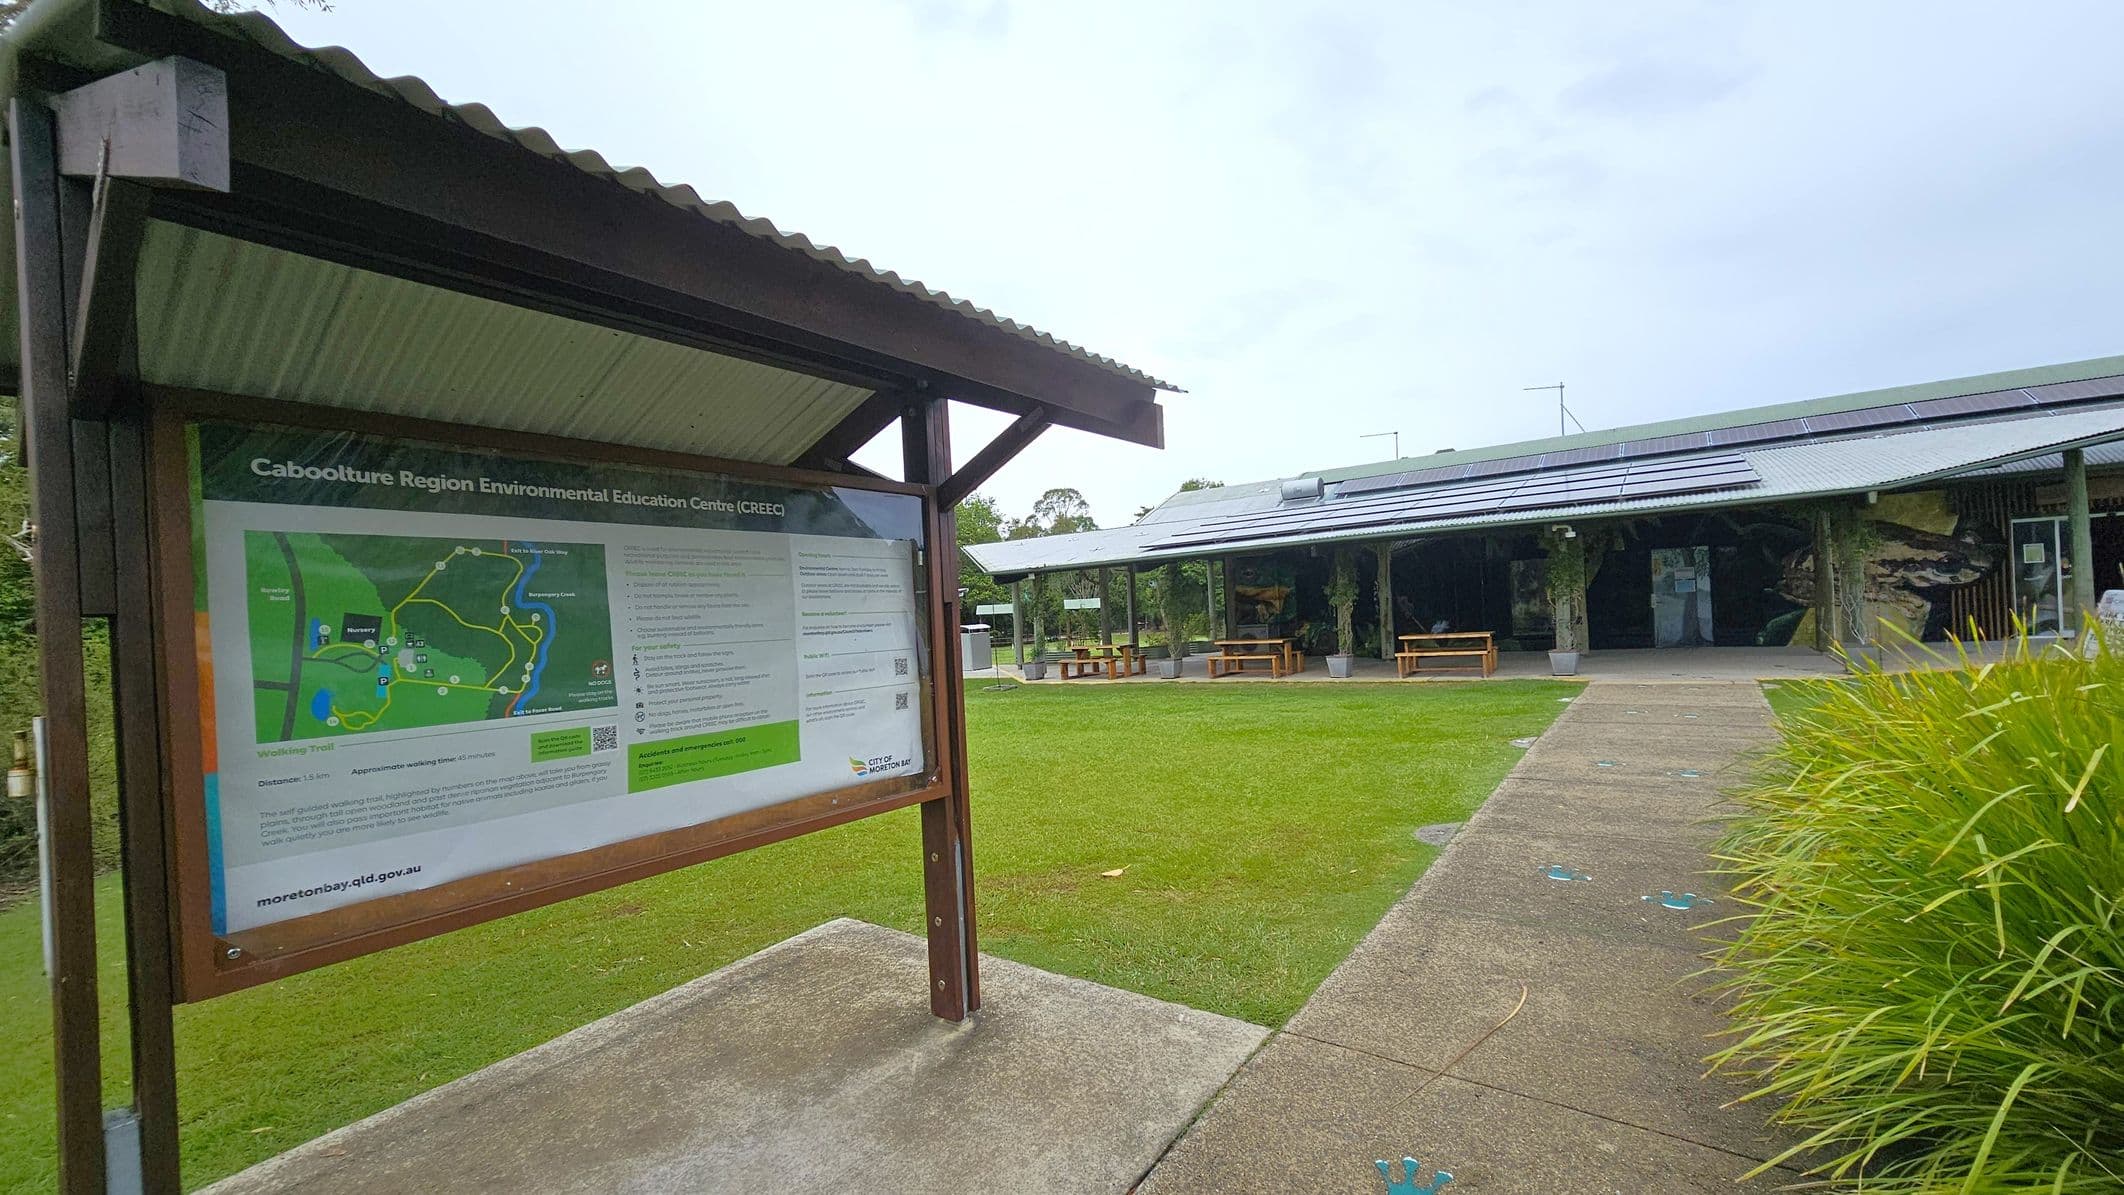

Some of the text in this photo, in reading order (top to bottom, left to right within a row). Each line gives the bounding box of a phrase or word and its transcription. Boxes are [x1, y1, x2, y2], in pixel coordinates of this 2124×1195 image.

[250, 458, 785, 517] Caboolture Region Environmental Education Centre (CREEC)
[256, 742, 334, 758] Walking Trail
[638, 749, 670, 759] Accidents
[671, 746, 684, 754] and
[684, 741, 722, 752] emergencies
[351, 763, 405, 776] Approximate
[406, 759, 437, 768] walking
[468, 752, 496, 760] minutes
[868, 754, 893, 766] CITY OF
[870, 759, 912, 774] MORETON BAY
[258, 777, 301, 788] Distance:
[316, 772, 330, 780] km
[260, 810, 276, 818] The
[280, 808, 295, 816] self
[297, 804, 328, 816] guided
[330, 799, 364, 809] walking
[442, 783, 474, 792] numbers
[293, 813, 328, 824] through
[330, 810, 344, 819] tall
[346, 807, 368, 817] open
[370, 799, 410, 811] woodland
[412, 796, 428, 804] and
[347, 816, 368, 826] pass
[369, 808, 408, 822] important
[262, 836, 282, 845] walk
[318, 830, 334, 840] you
[352, 824, 374, 832] more
[256, 864, 422, 908] moretonbay.qld.gov.au
